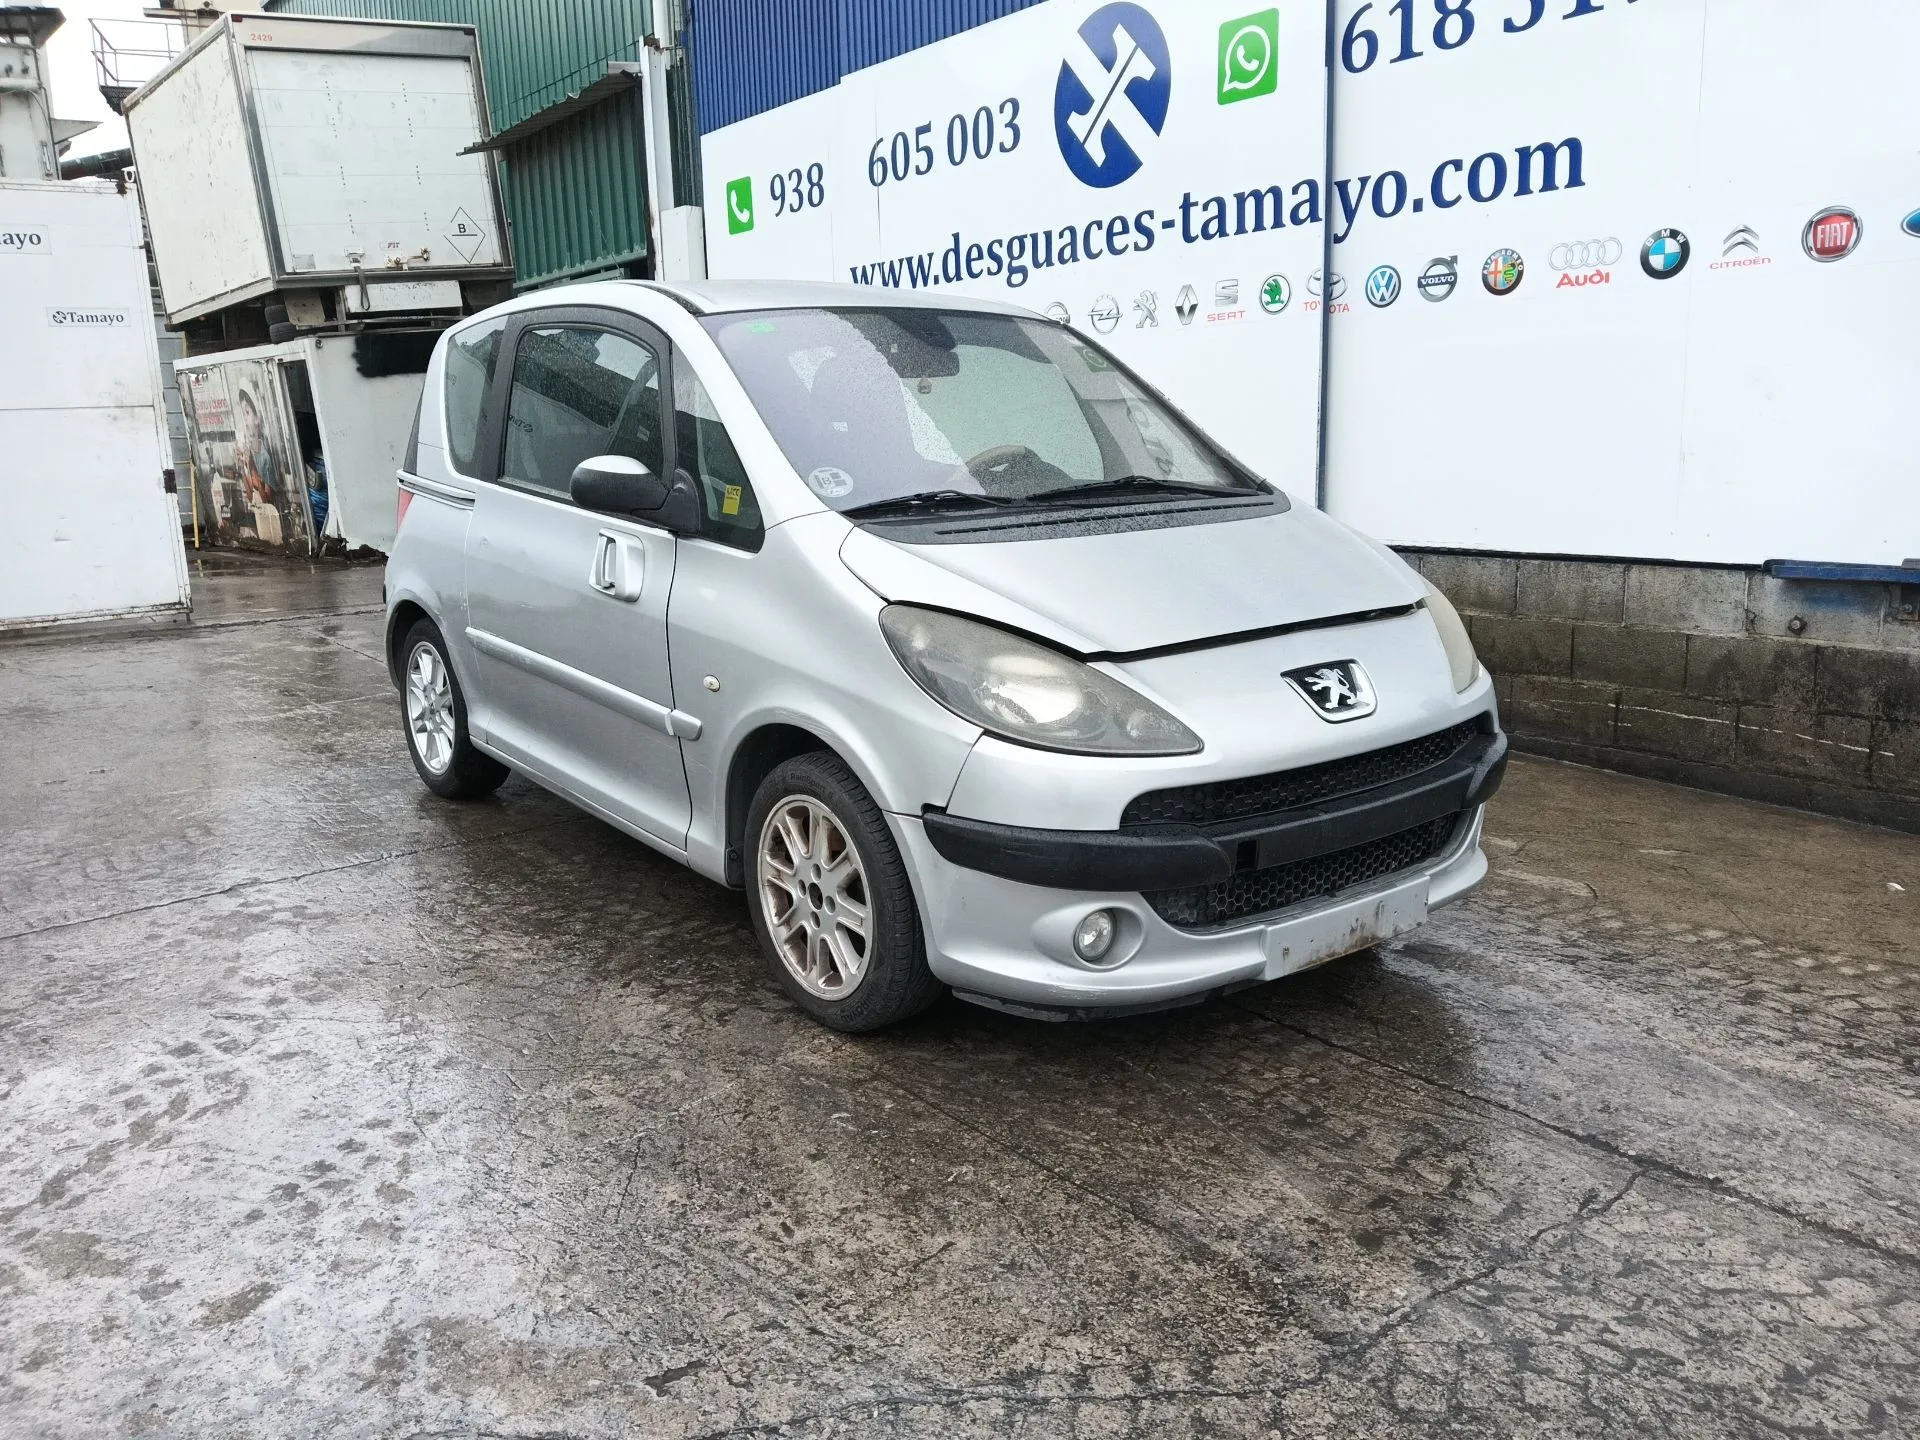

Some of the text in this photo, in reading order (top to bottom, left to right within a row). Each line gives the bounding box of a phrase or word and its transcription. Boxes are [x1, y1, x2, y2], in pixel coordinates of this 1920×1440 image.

[1341, 0, 1475, 74] 618
[769, 97, 1021, 218] 938 605 003
[457, 223, 467, 234] B
[1646, 228, 1687, 247] BMW
[1816, 221, 1851, 249] FIAT
[0, 231, 42, 250] ayo
[1420, 274, 1455, 286] VOLVO
[1555, 269, 1610, 289] Audi
[66, 311, 125, 326] Tamayo
[1207, 310, 1246, 322] SEAT
